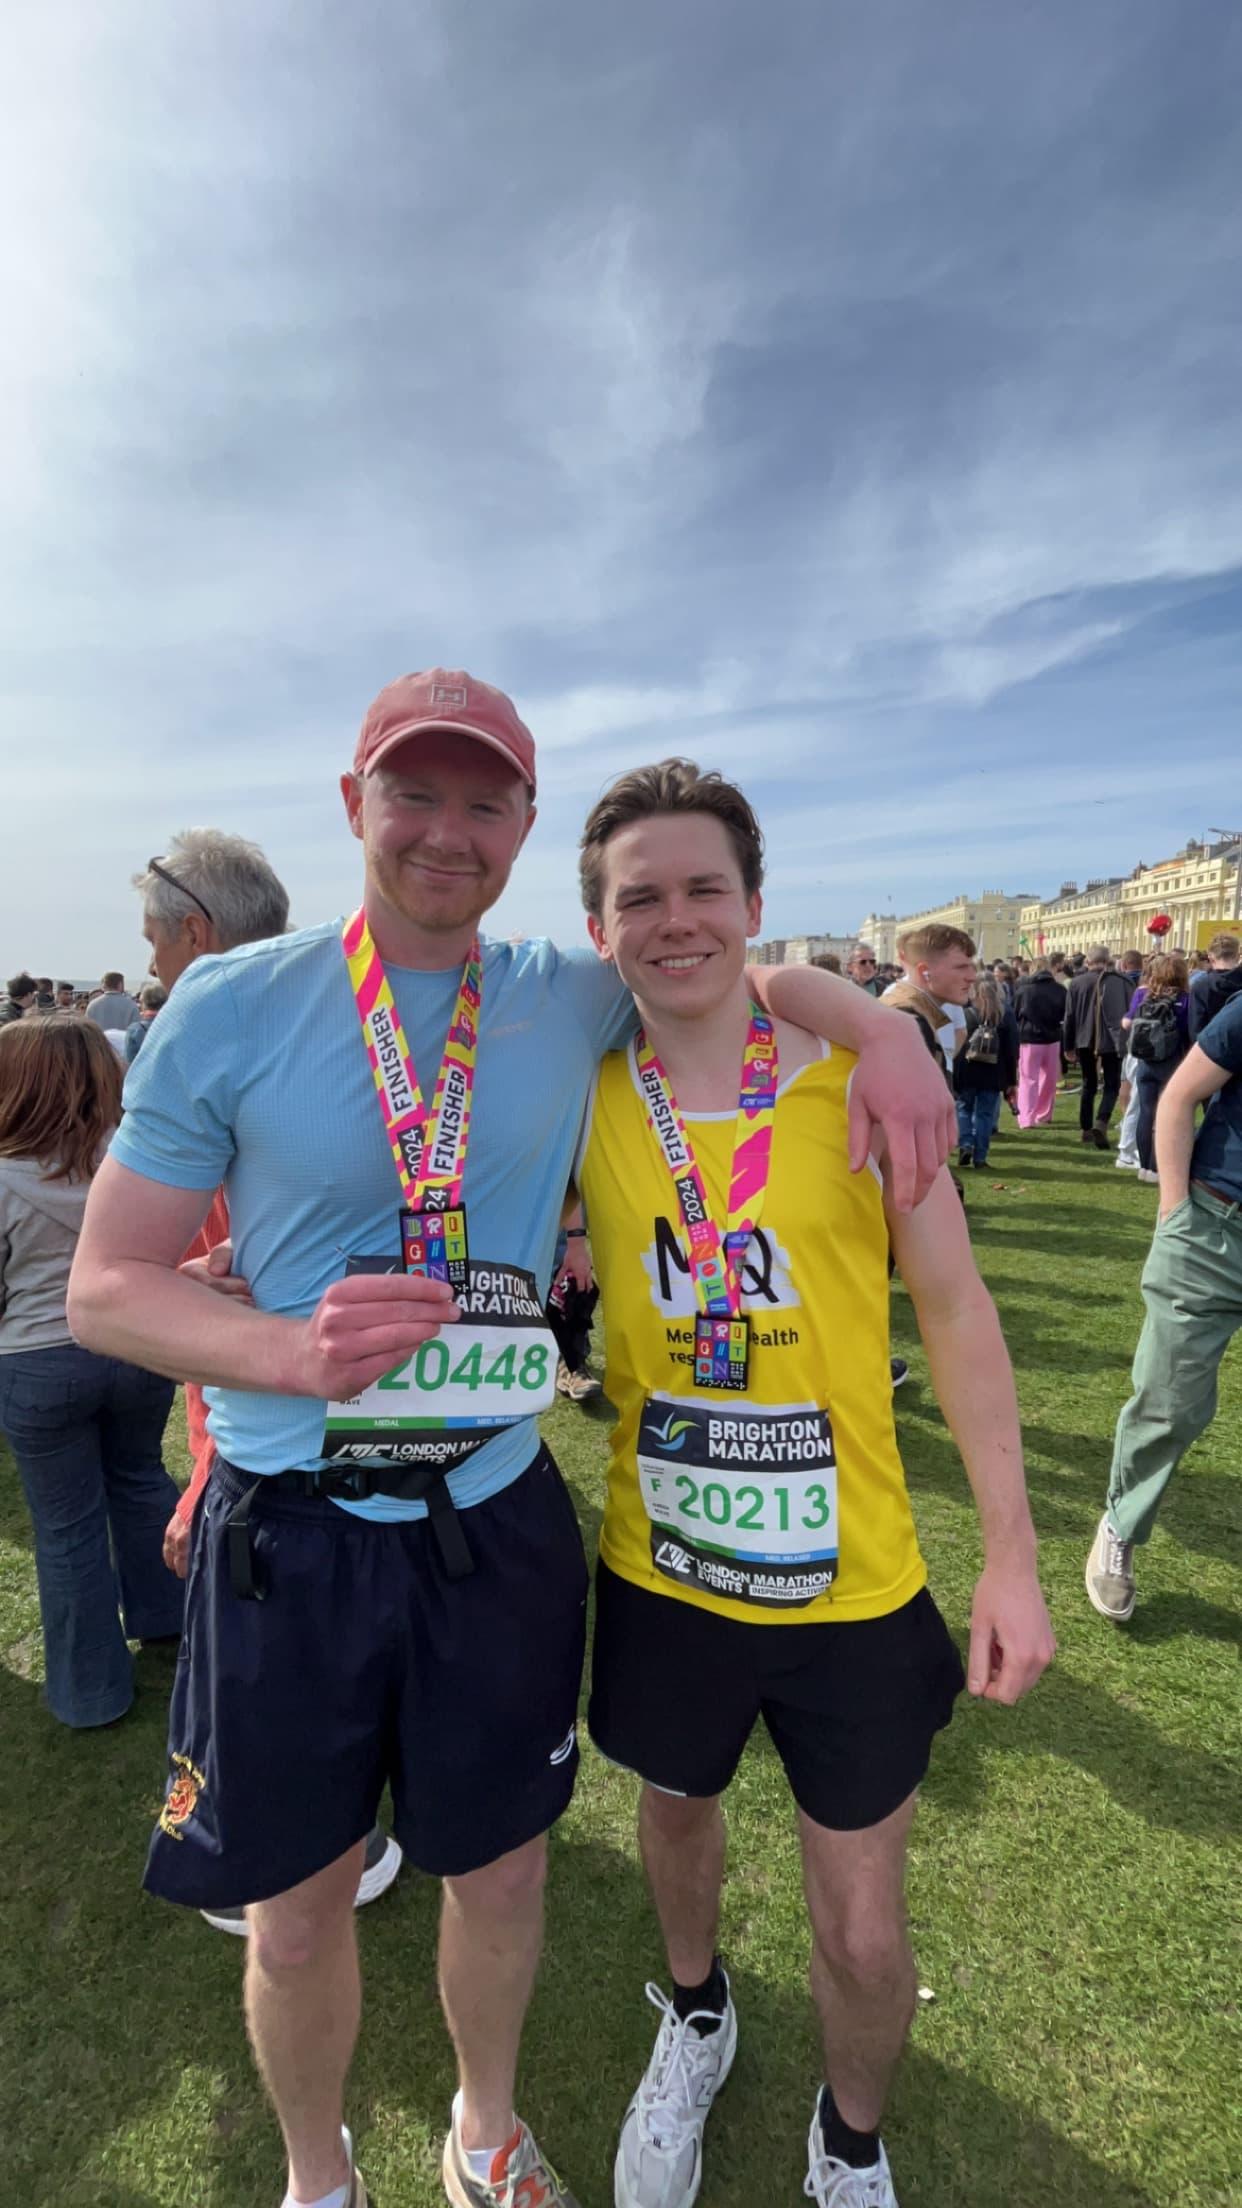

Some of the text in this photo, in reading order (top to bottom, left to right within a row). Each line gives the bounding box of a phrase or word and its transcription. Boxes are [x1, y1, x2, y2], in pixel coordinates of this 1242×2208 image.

[372, 1007, 412, 1112] FINISHER
[434, 1070, 465, 1171] FINISHER
[642, 1071, 686, 1163] FINISHER
[425, 1188, 447, 1211] 24
[679, 1178, 704, 1222] 2024
[469, 1270, 529, 1299] IGHTON
[455, 1291, 544, 1318] ARATHON
[752, 1328, 799, 1346] ealth
[708, 1419, 820, 1441] BRIGHTON
[392, 1442, 457, 1456] LONDON
[708, 1438, 831, 1462] MARATHON
[675, 1475, 830, 1531] 20213
[696, 1558, 751, 1583] LONDON
[753, 1571, 833, 1588] MARATHON
[698, 1570, 743, 1594] EVENTS
[751, 1586, 794, 1597] INSPIRING
